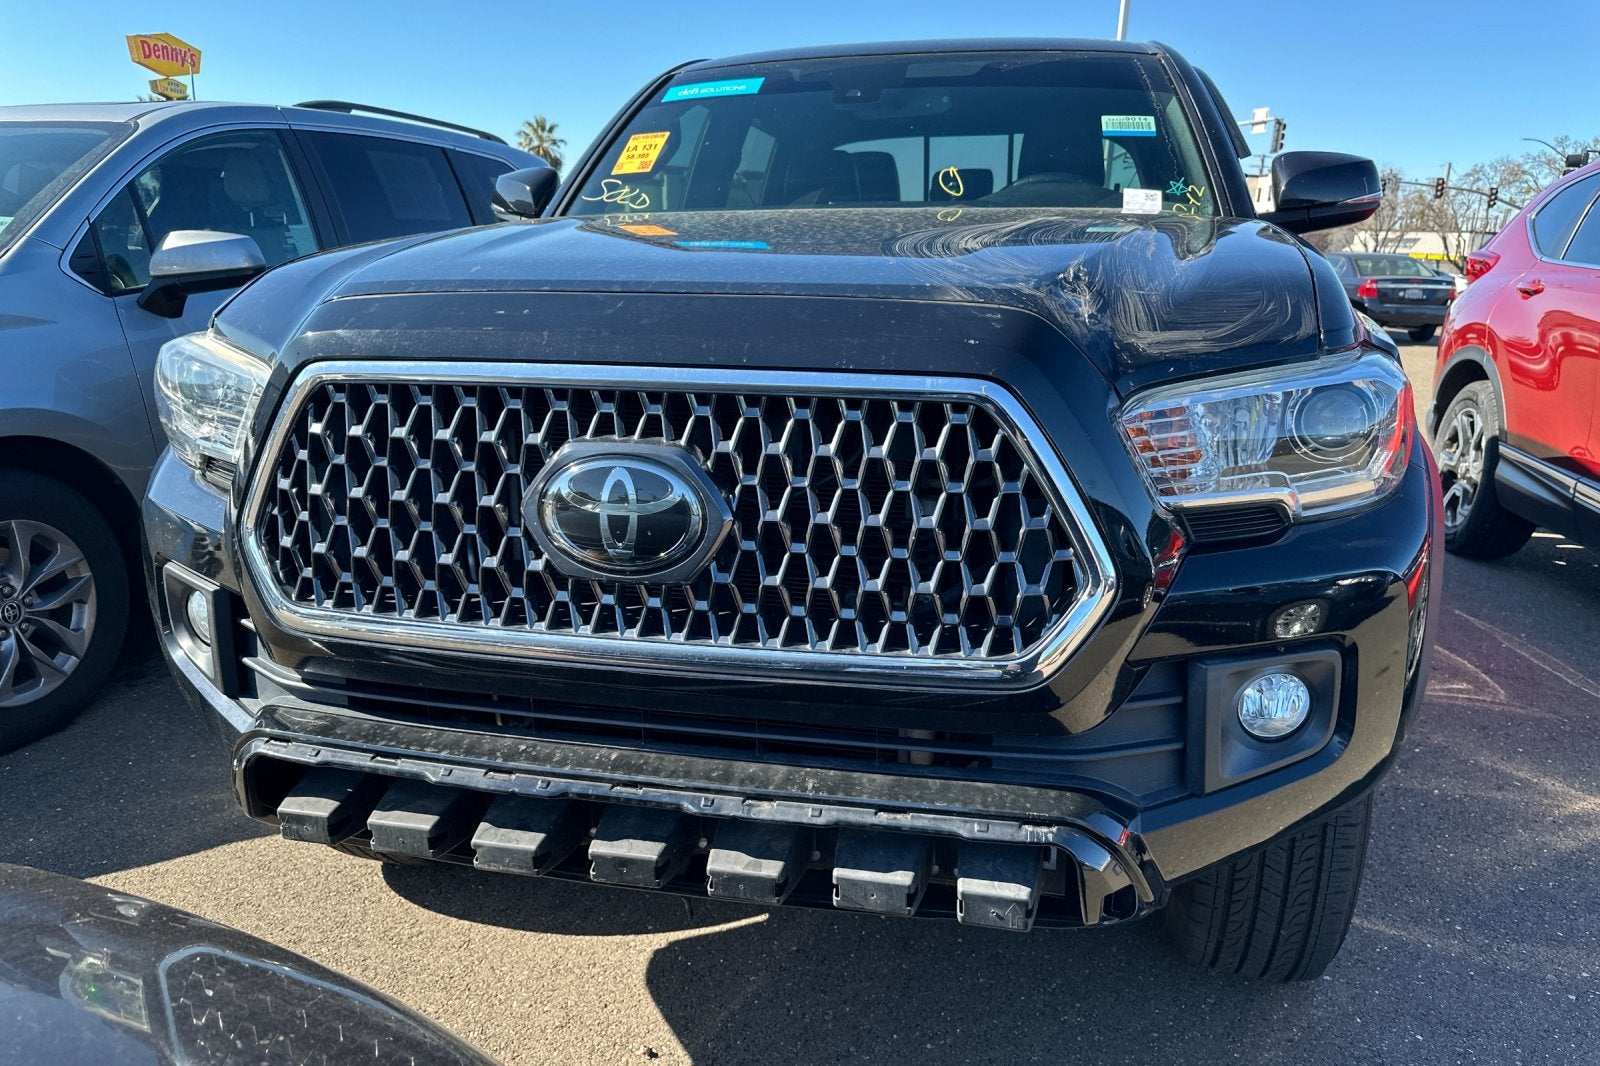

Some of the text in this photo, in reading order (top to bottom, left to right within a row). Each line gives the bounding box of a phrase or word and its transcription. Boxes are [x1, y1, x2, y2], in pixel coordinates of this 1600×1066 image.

[140, 39, 196, 68] Denny's
[700, 85, 747, 93] SOLUTIONS
[626, 143, 658, 153] LA 131
